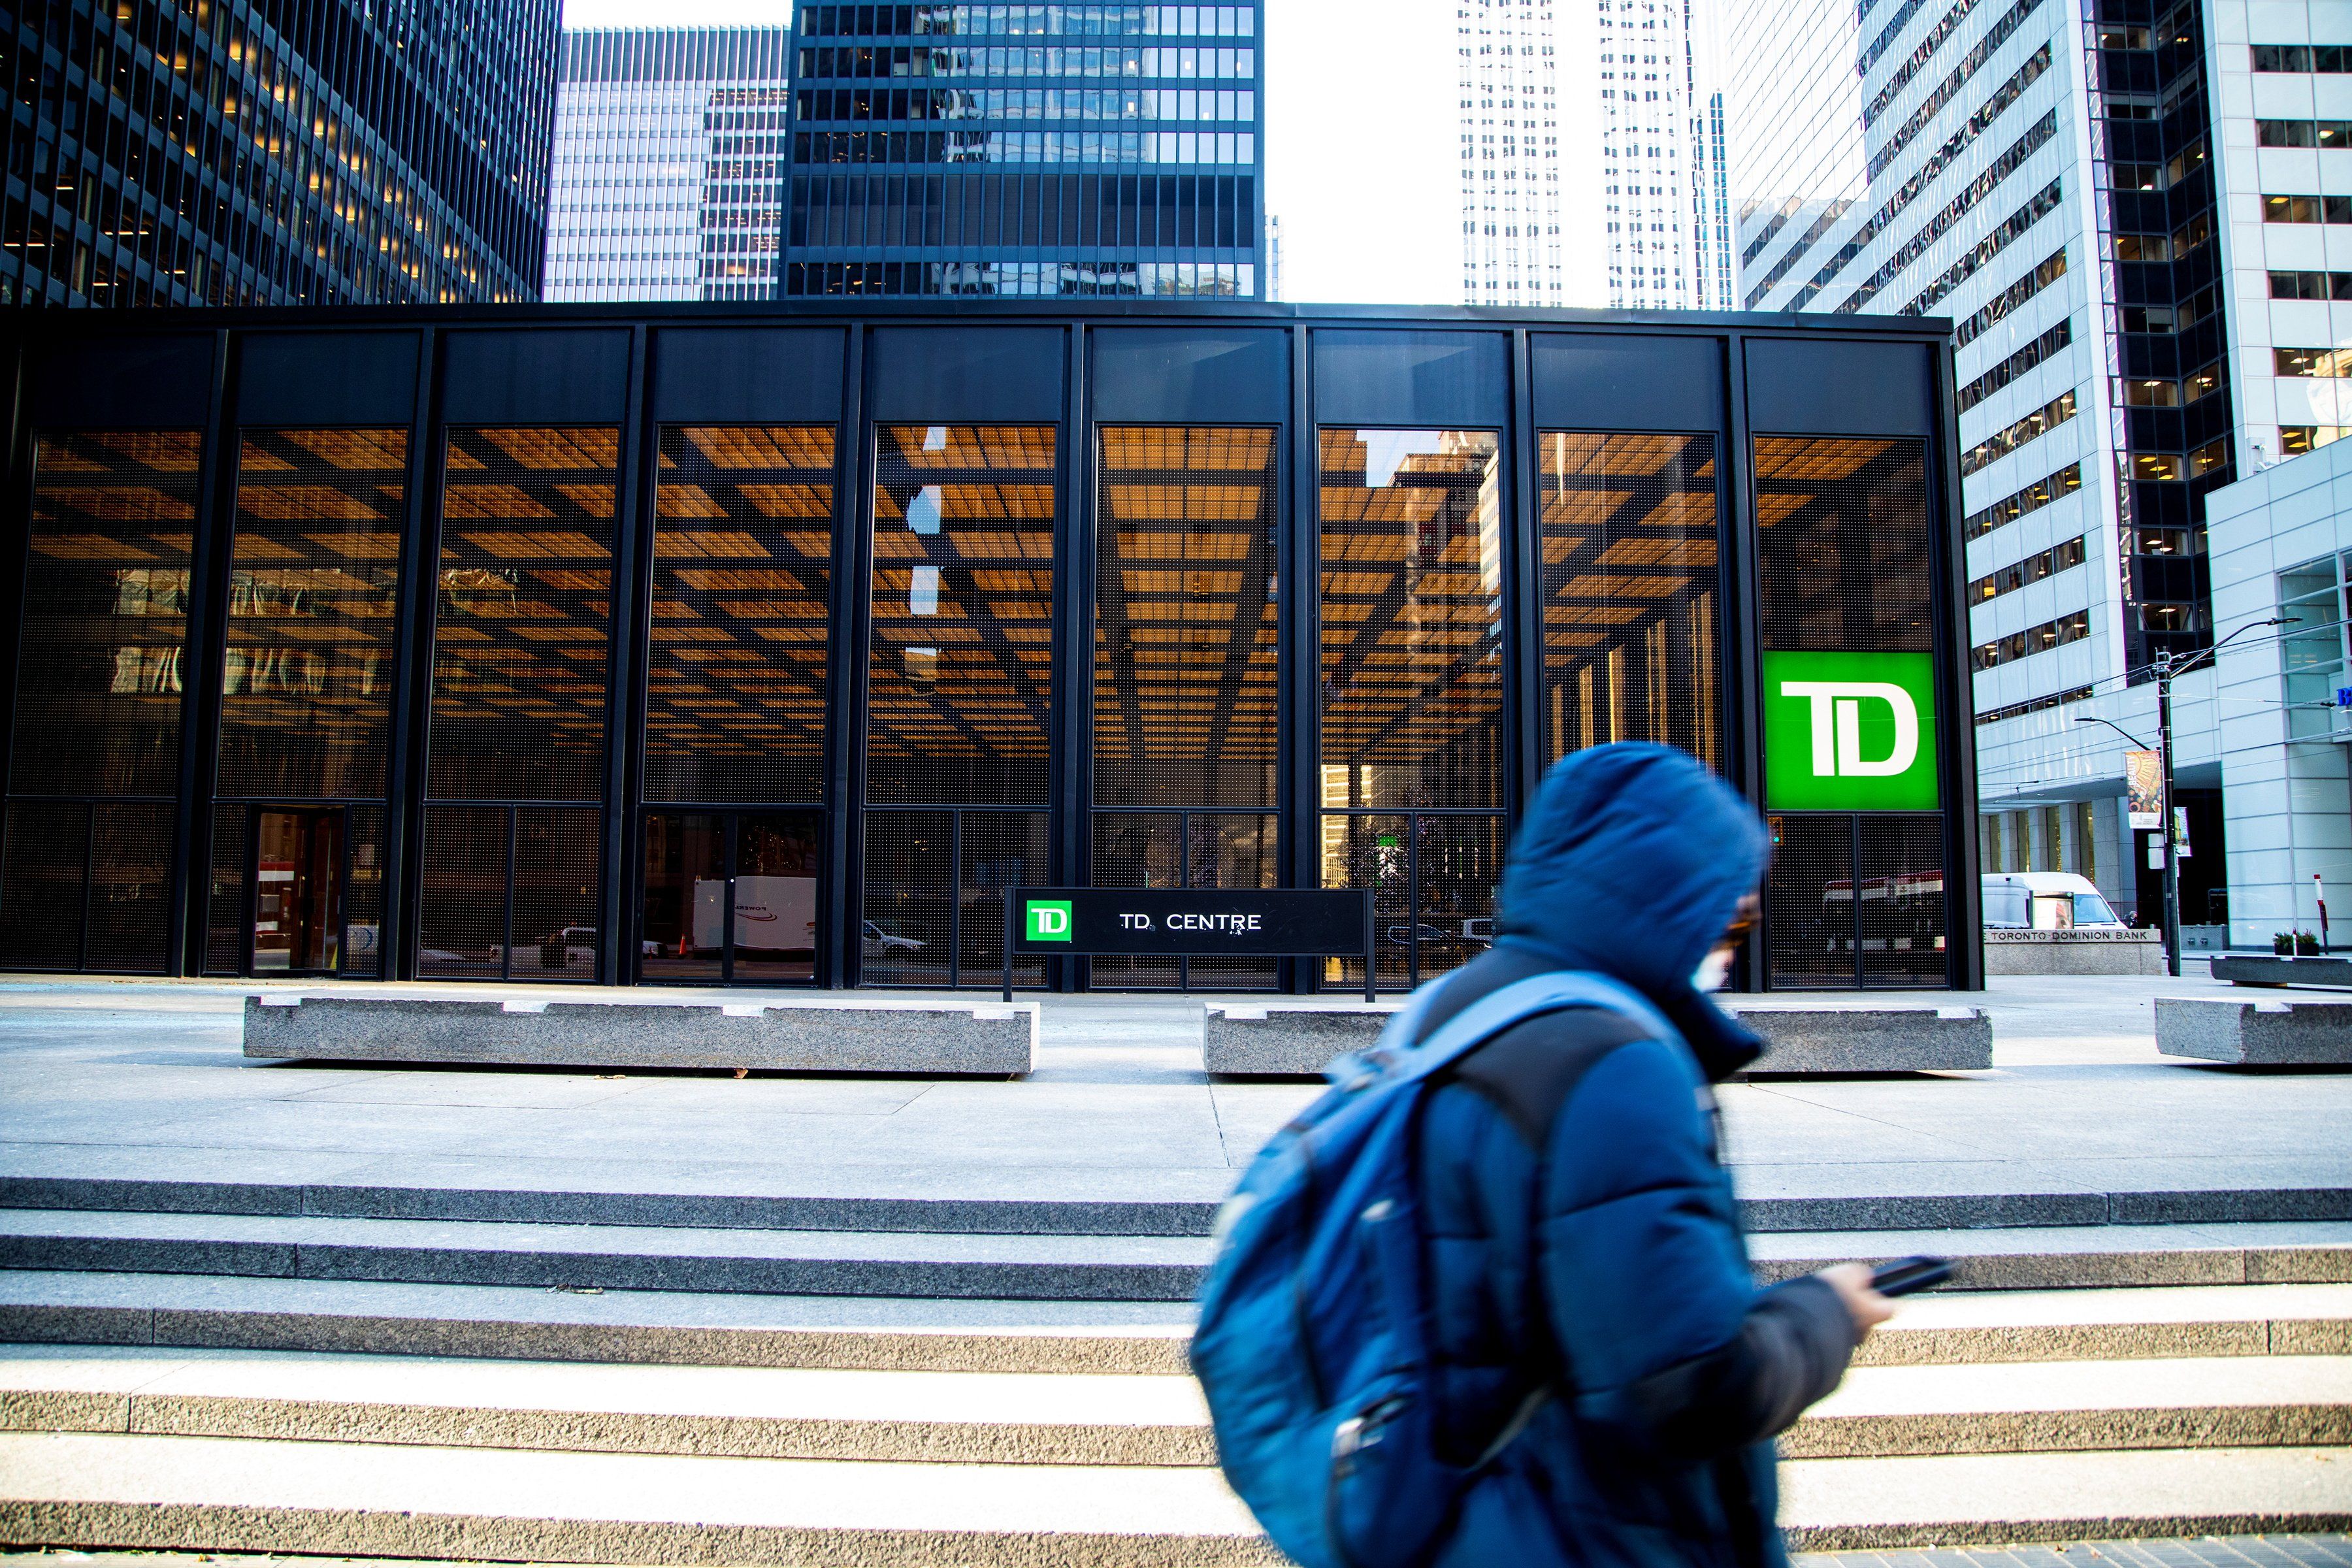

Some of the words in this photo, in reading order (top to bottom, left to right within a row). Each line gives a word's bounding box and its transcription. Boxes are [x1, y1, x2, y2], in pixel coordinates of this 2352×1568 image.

[2337, 687, 2352, 706] B
[1781, 681, 1918, 776] TD
[2125, 755, 2137, 786] BEAUTY
[1031, 908, 1068, 934] TD
[1119, 914, 1150, 929] TD
[1167, 914, 1262, 930] CENTRE
